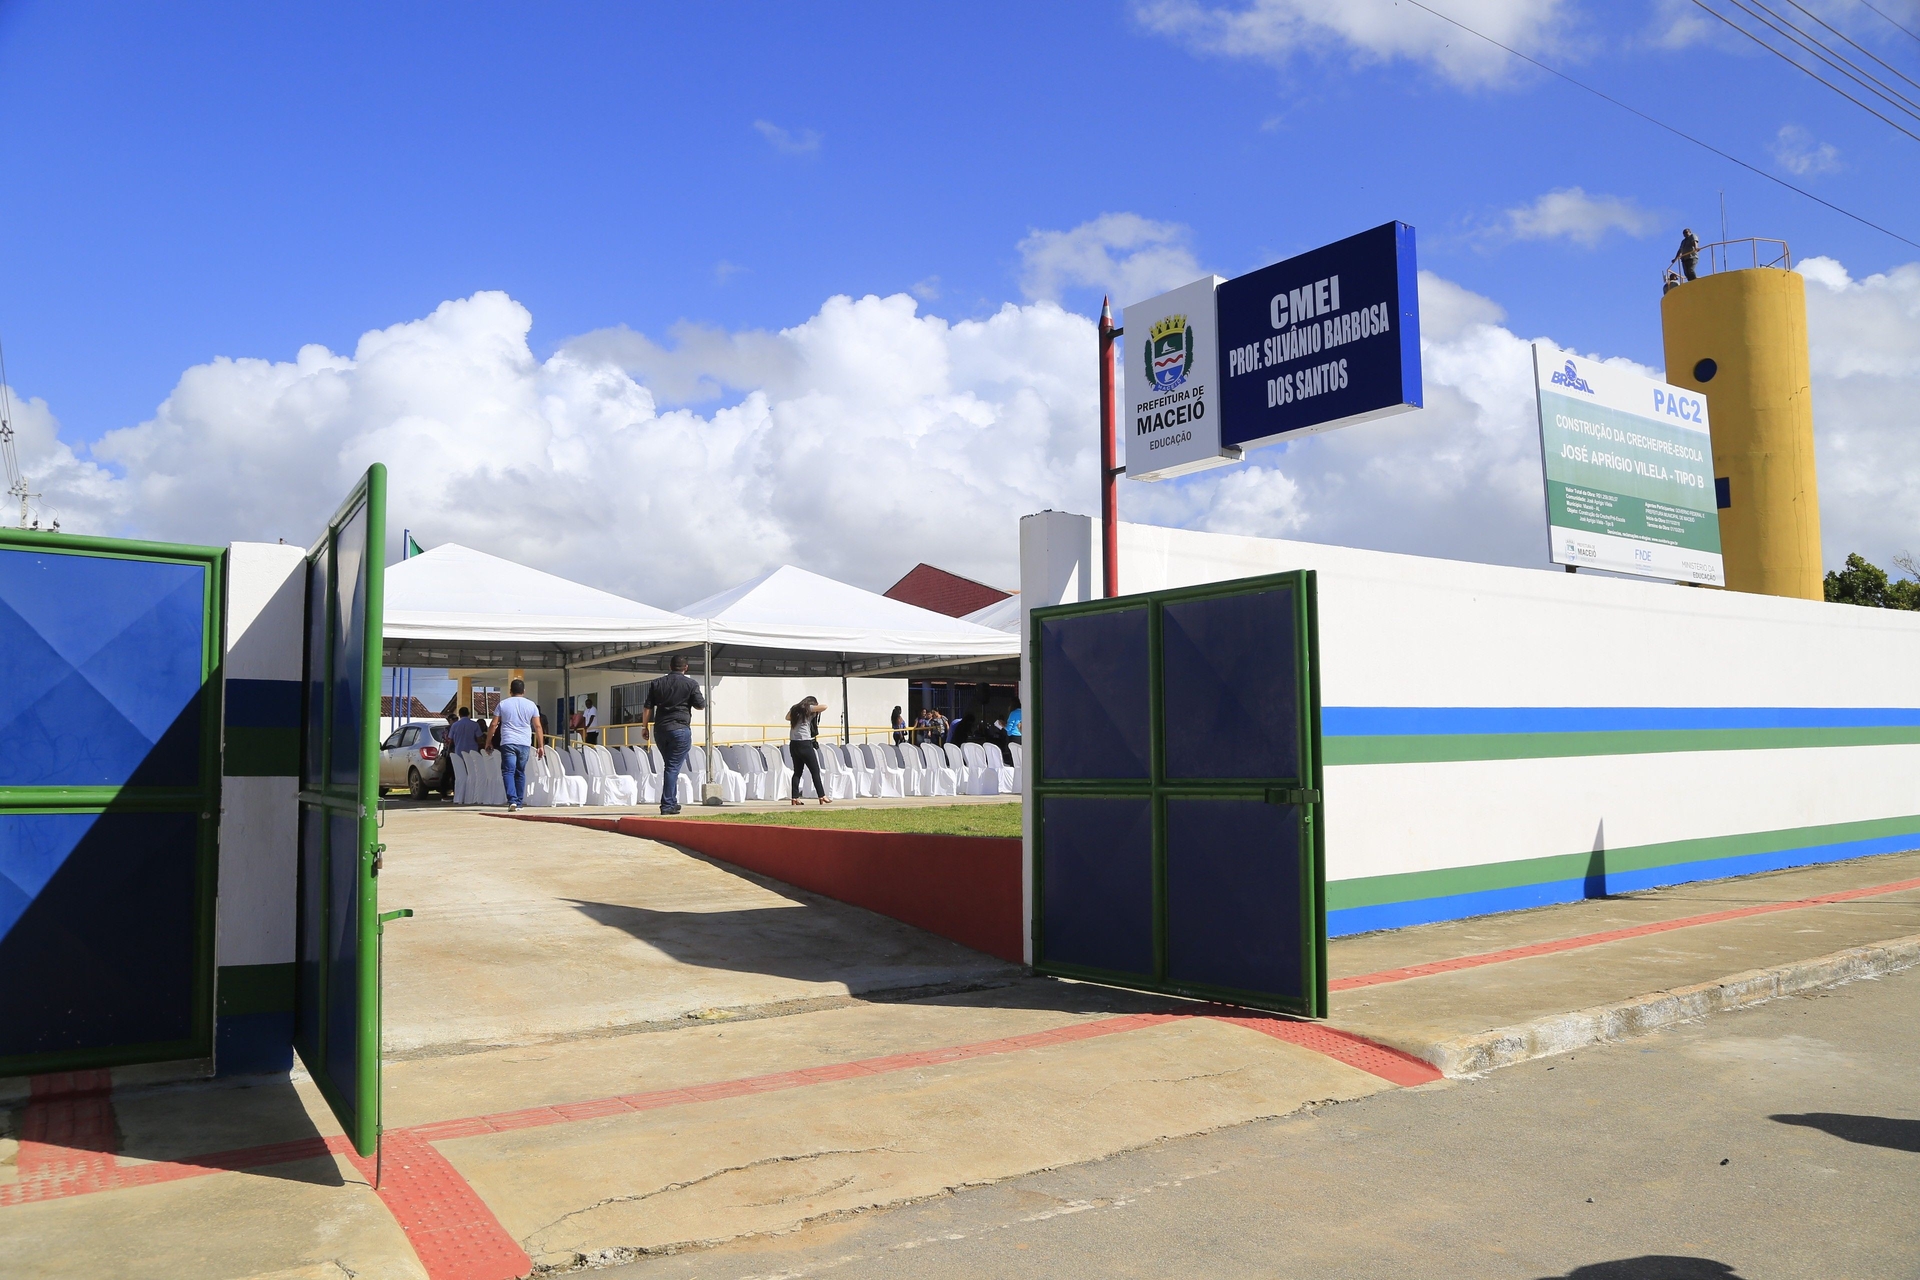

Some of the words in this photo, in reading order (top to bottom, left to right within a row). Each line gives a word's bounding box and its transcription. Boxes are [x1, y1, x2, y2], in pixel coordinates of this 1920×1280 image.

[1270, 274, 1340, 329] CMEI
[1230, 342, 1262, 378] PROF.
[1264, 324, 1322, 368] SILVÂNIO
[1324, 302, 1390, 350] BARBOSA
[1268, 374, 1294, 408] DOS
[1296, 358, 1348, 400] SANTOS
[1551, 371, 1594, 394] BRASIL
[1137, 390, 1190, 413] PREFEITURA
[1192, 385, 1204, 397] DE
[1654, 388, 1702, 424] PAC2
[1137, 396, 1204, 436] MACEIÓ
[1556, 414, 1612, 440] CONSTRUÇÃO
[1614, 429, 1626, 443] DA
[1150, 430, 1192, 450] EDUCAÇÃO
[1561, 444, 1588, 463] JOSÉ
[1591, 451, 1632, 472] APRÍGIO
[1634, 460, 1668, 480] VILELA
[1674, 470, 1696, 486] TIPO
[1698, 475, 1704, 488] B
[1577, 548, 1596, 558] MACEIÓ
[1635, 549, 1651, 561] FNDE
[1682, 561, 1707, 571] MINISTÉRIO
[1693, 572, 1716, 581] EDUCAÇÃO
